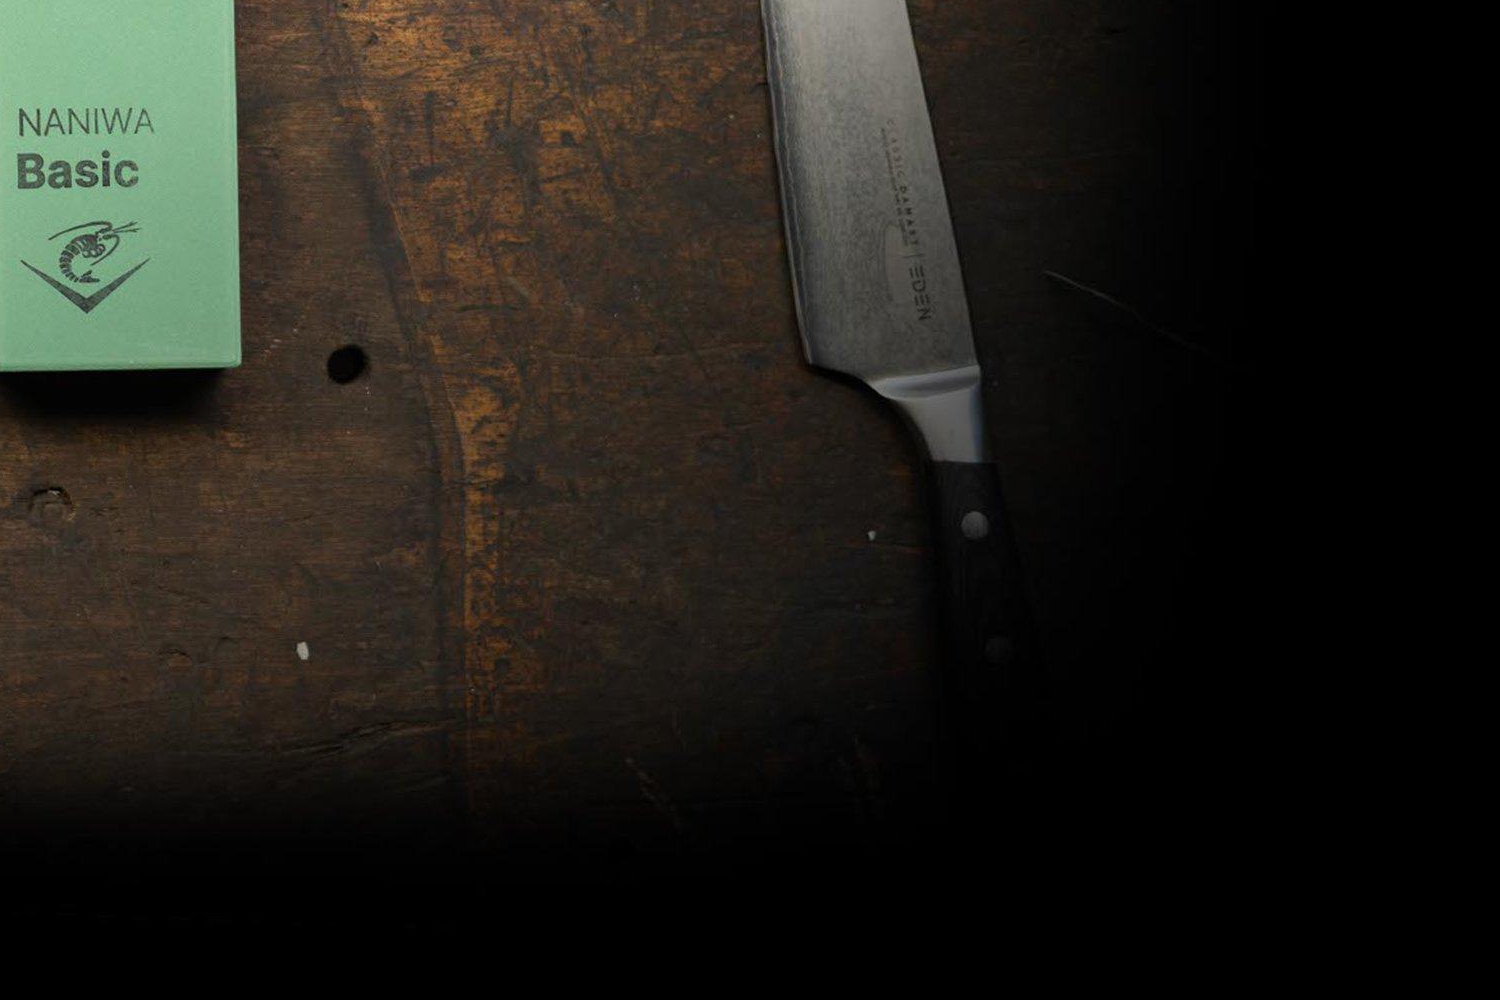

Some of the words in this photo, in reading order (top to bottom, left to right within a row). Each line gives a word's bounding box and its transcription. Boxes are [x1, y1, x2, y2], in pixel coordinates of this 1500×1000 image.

[18, 107, 155, 137] NANIWA
[16, 149, 140, 190] Basic
[908, 264, 932, 322] EDEN
